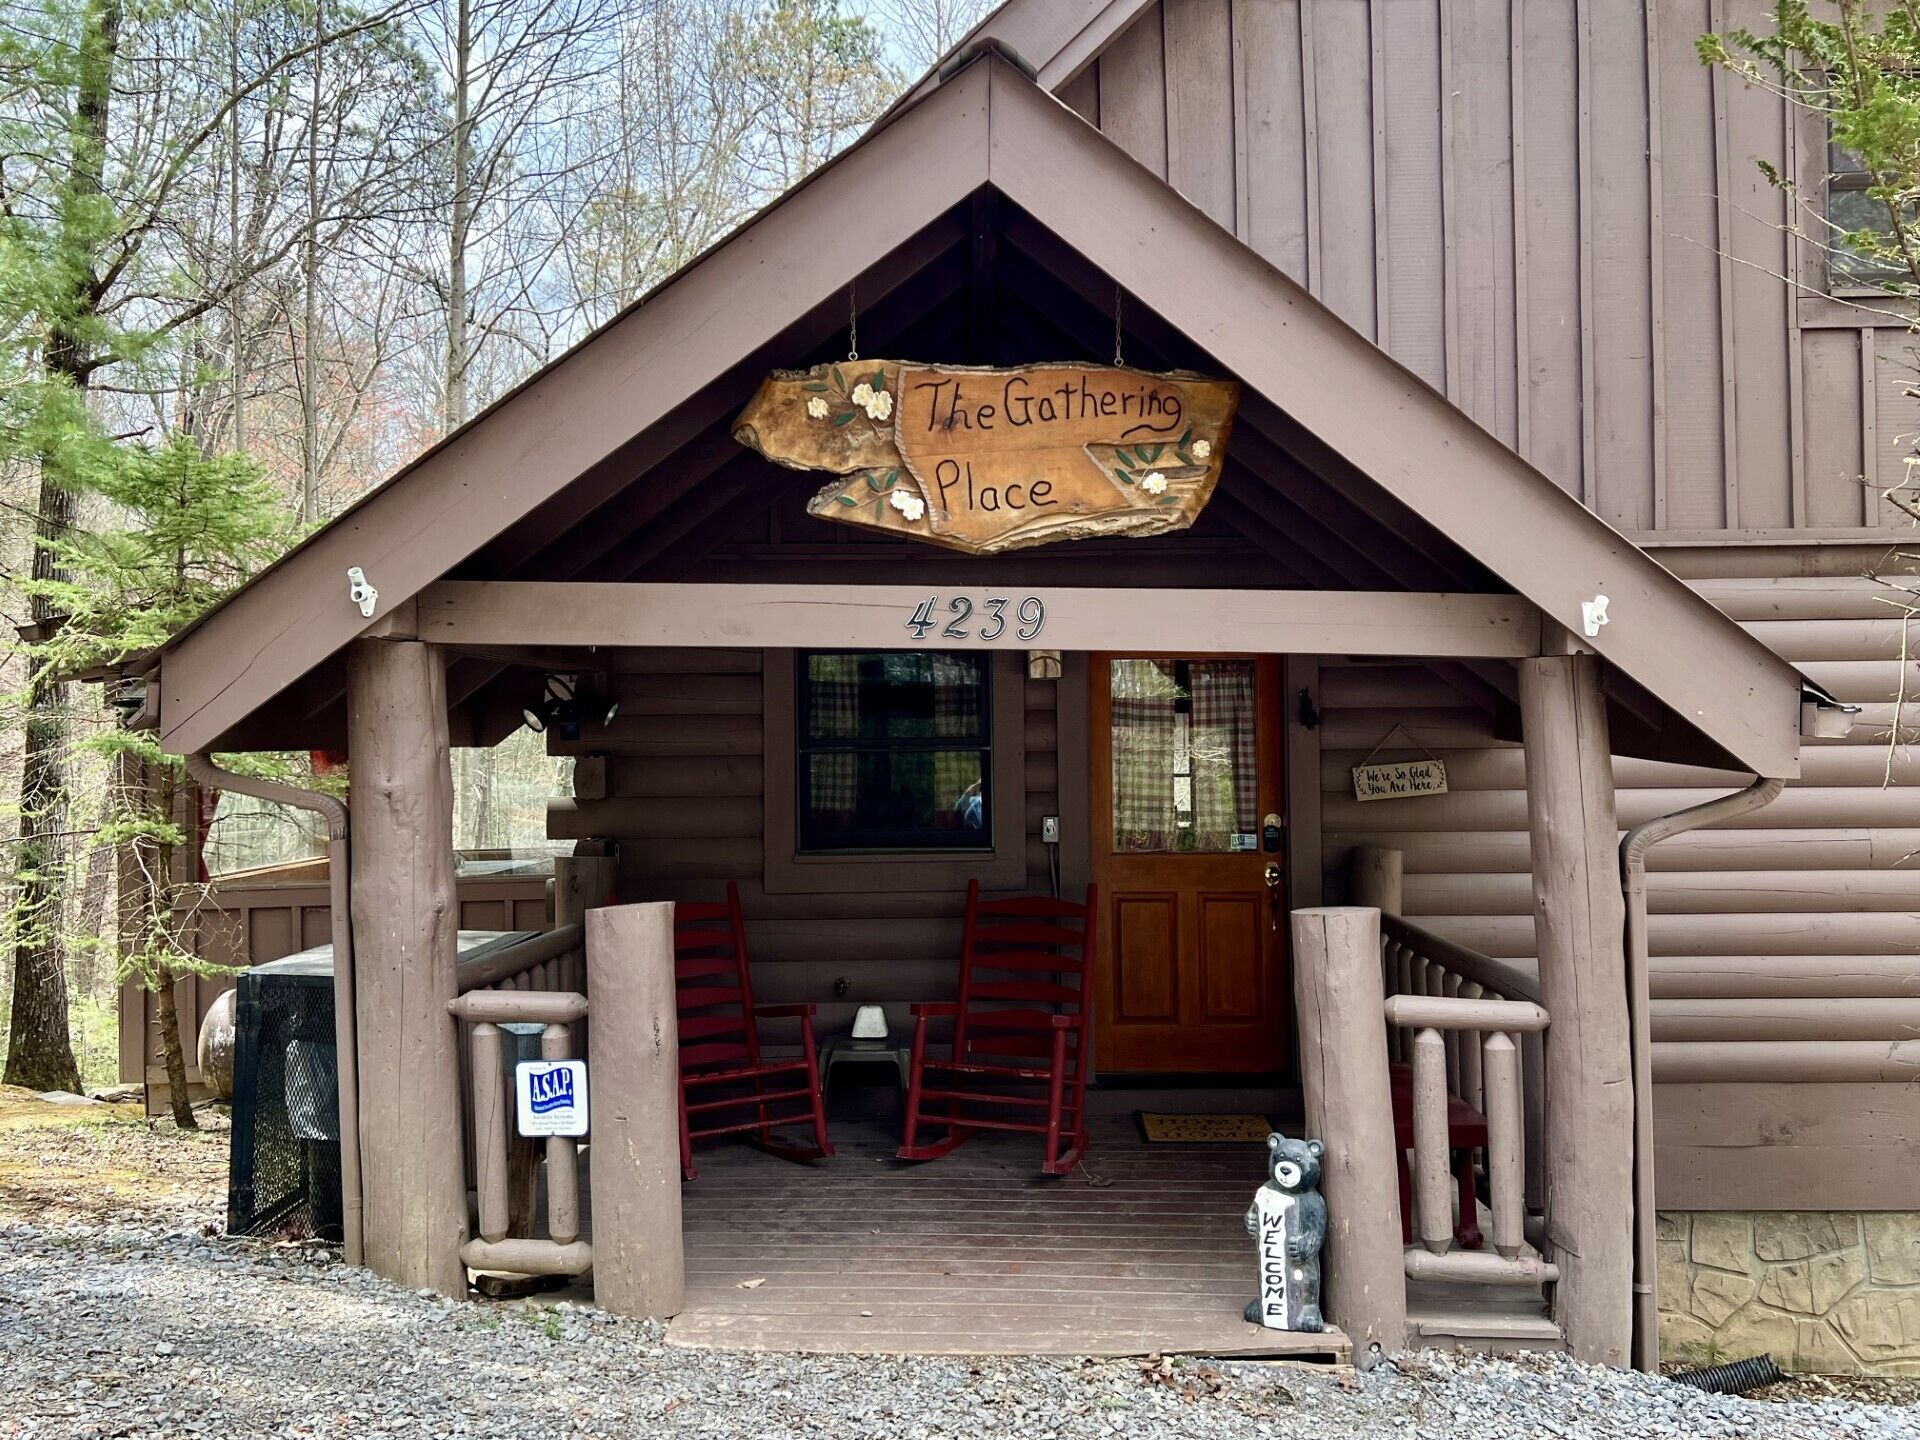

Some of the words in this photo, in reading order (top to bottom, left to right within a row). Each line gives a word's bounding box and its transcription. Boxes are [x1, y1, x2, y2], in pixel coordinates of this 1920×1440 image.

[914, 379, 996, 431] The
[1004, 375, 1182, 439] Gathering
[935, 459, 1058, 511] Place
[905, 595, 1046, 640] 4239
[1366, 769, 1391, 782] We're
[1395, 767, 1406, 779] So
[1409, 766, 1432, 778] Glad
[1367, 782, 1386, 795] You
[1390, 780, 1407, 792] Are
[1263, 1212, 1284, 1316] WELCOME
